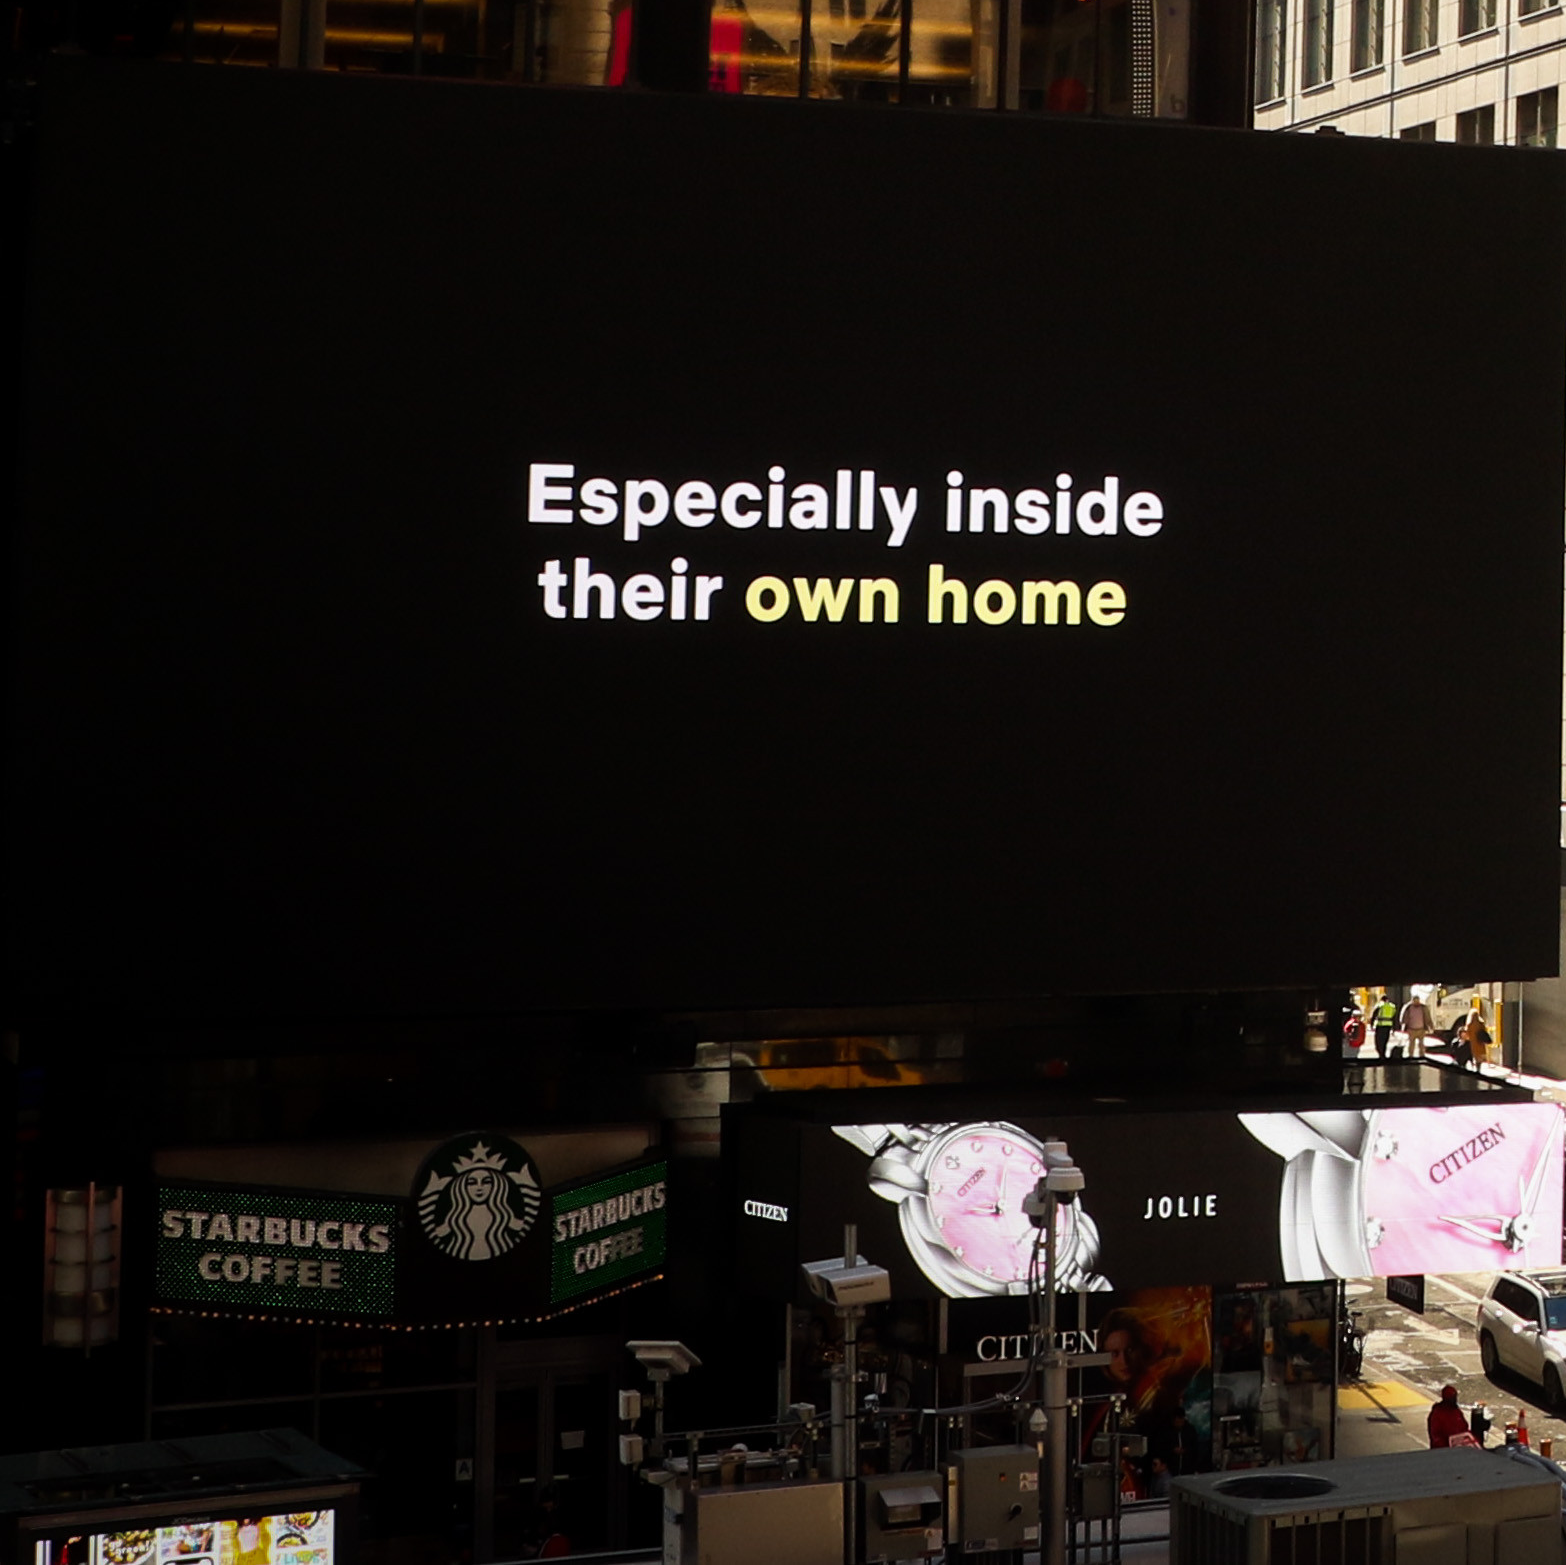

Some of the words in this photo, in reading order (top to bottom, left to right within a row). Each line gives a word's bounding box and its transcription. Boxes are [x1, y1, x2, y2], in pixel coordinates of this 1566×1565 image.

[528, 464, 918, 546] Especially
[945, 470, 1164, 537] inside
[538, 556, 723, 621] their
[745, 574, 900, 623] own
[928, 564, 1127, 626] home
[1429, 1122, 1506, 1184] CITIZEN
[957, 1167, 987, 1198] CITIZEN
[554, 1181, 666, 1241] STARBUCKS
[744, 1199, 789, 1223] CITIZEN
[1144, 1194, 1218, 1220] JOLIE
[160, 1209, 392, 1254] STARBUCKS
[573, 1226, 644, 1275] COFFEE
[198, 1252, 343, 1291] COFFEE
